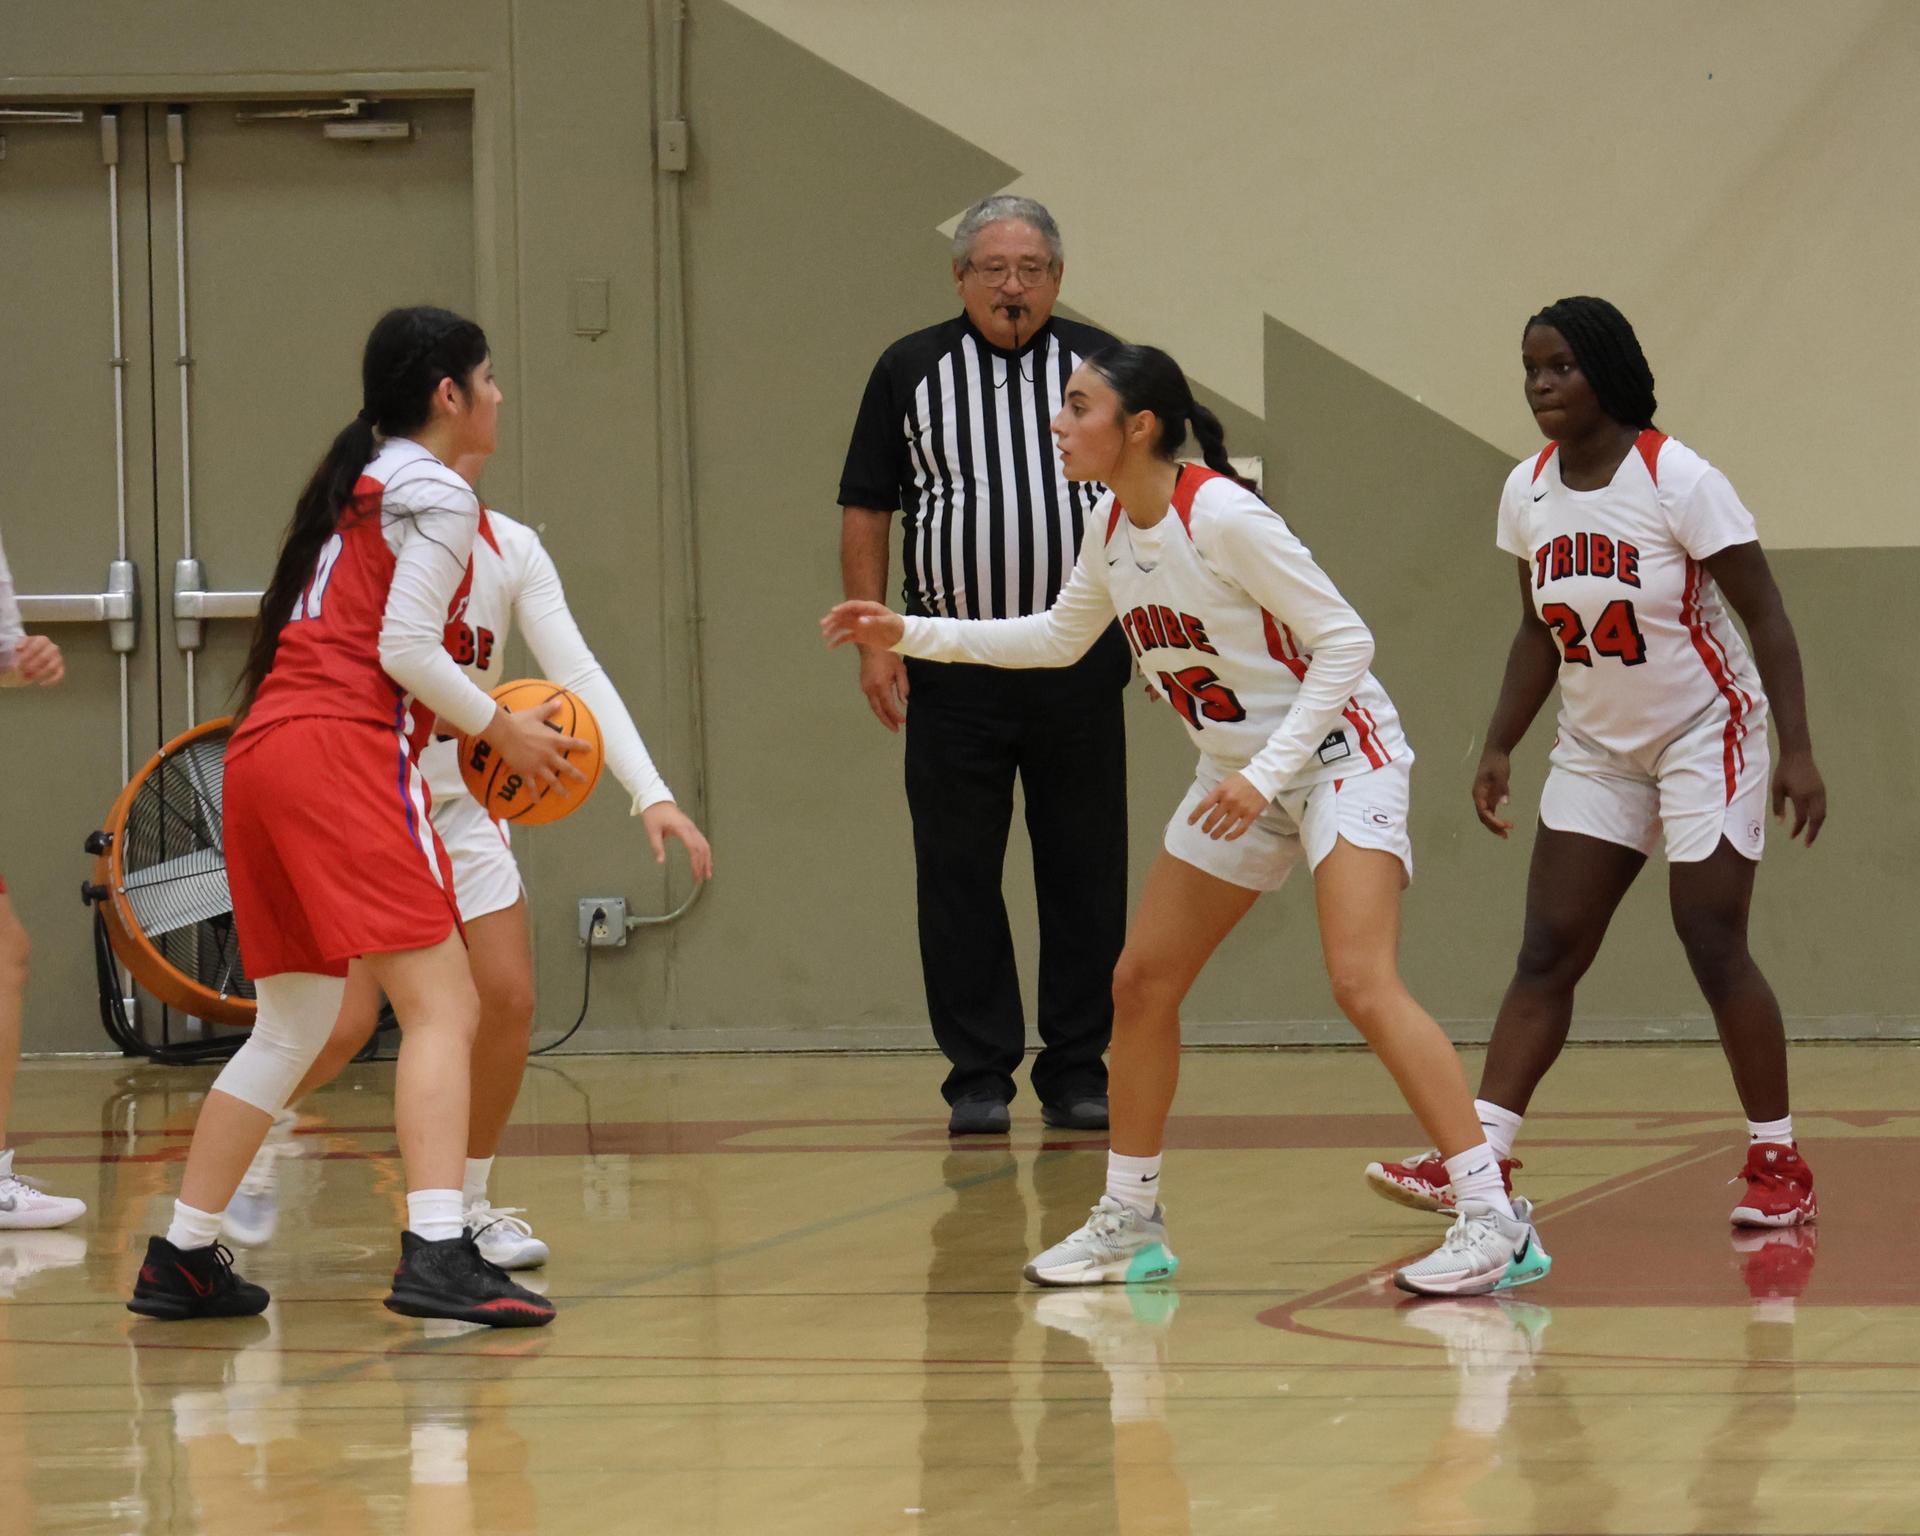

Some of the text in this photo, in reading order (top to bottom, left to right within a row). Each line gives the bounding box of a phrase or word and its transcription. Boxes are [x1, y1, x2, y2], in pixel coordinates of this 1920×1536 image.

[1535, 532, 1641, 589] TRIBE
[1122, 604, 1219, 658] TRIBE
[1542, 599, 1647, 667] 24
[1156, 665, 1247, 731] 15
[1325, 735, 1337, 746] M
